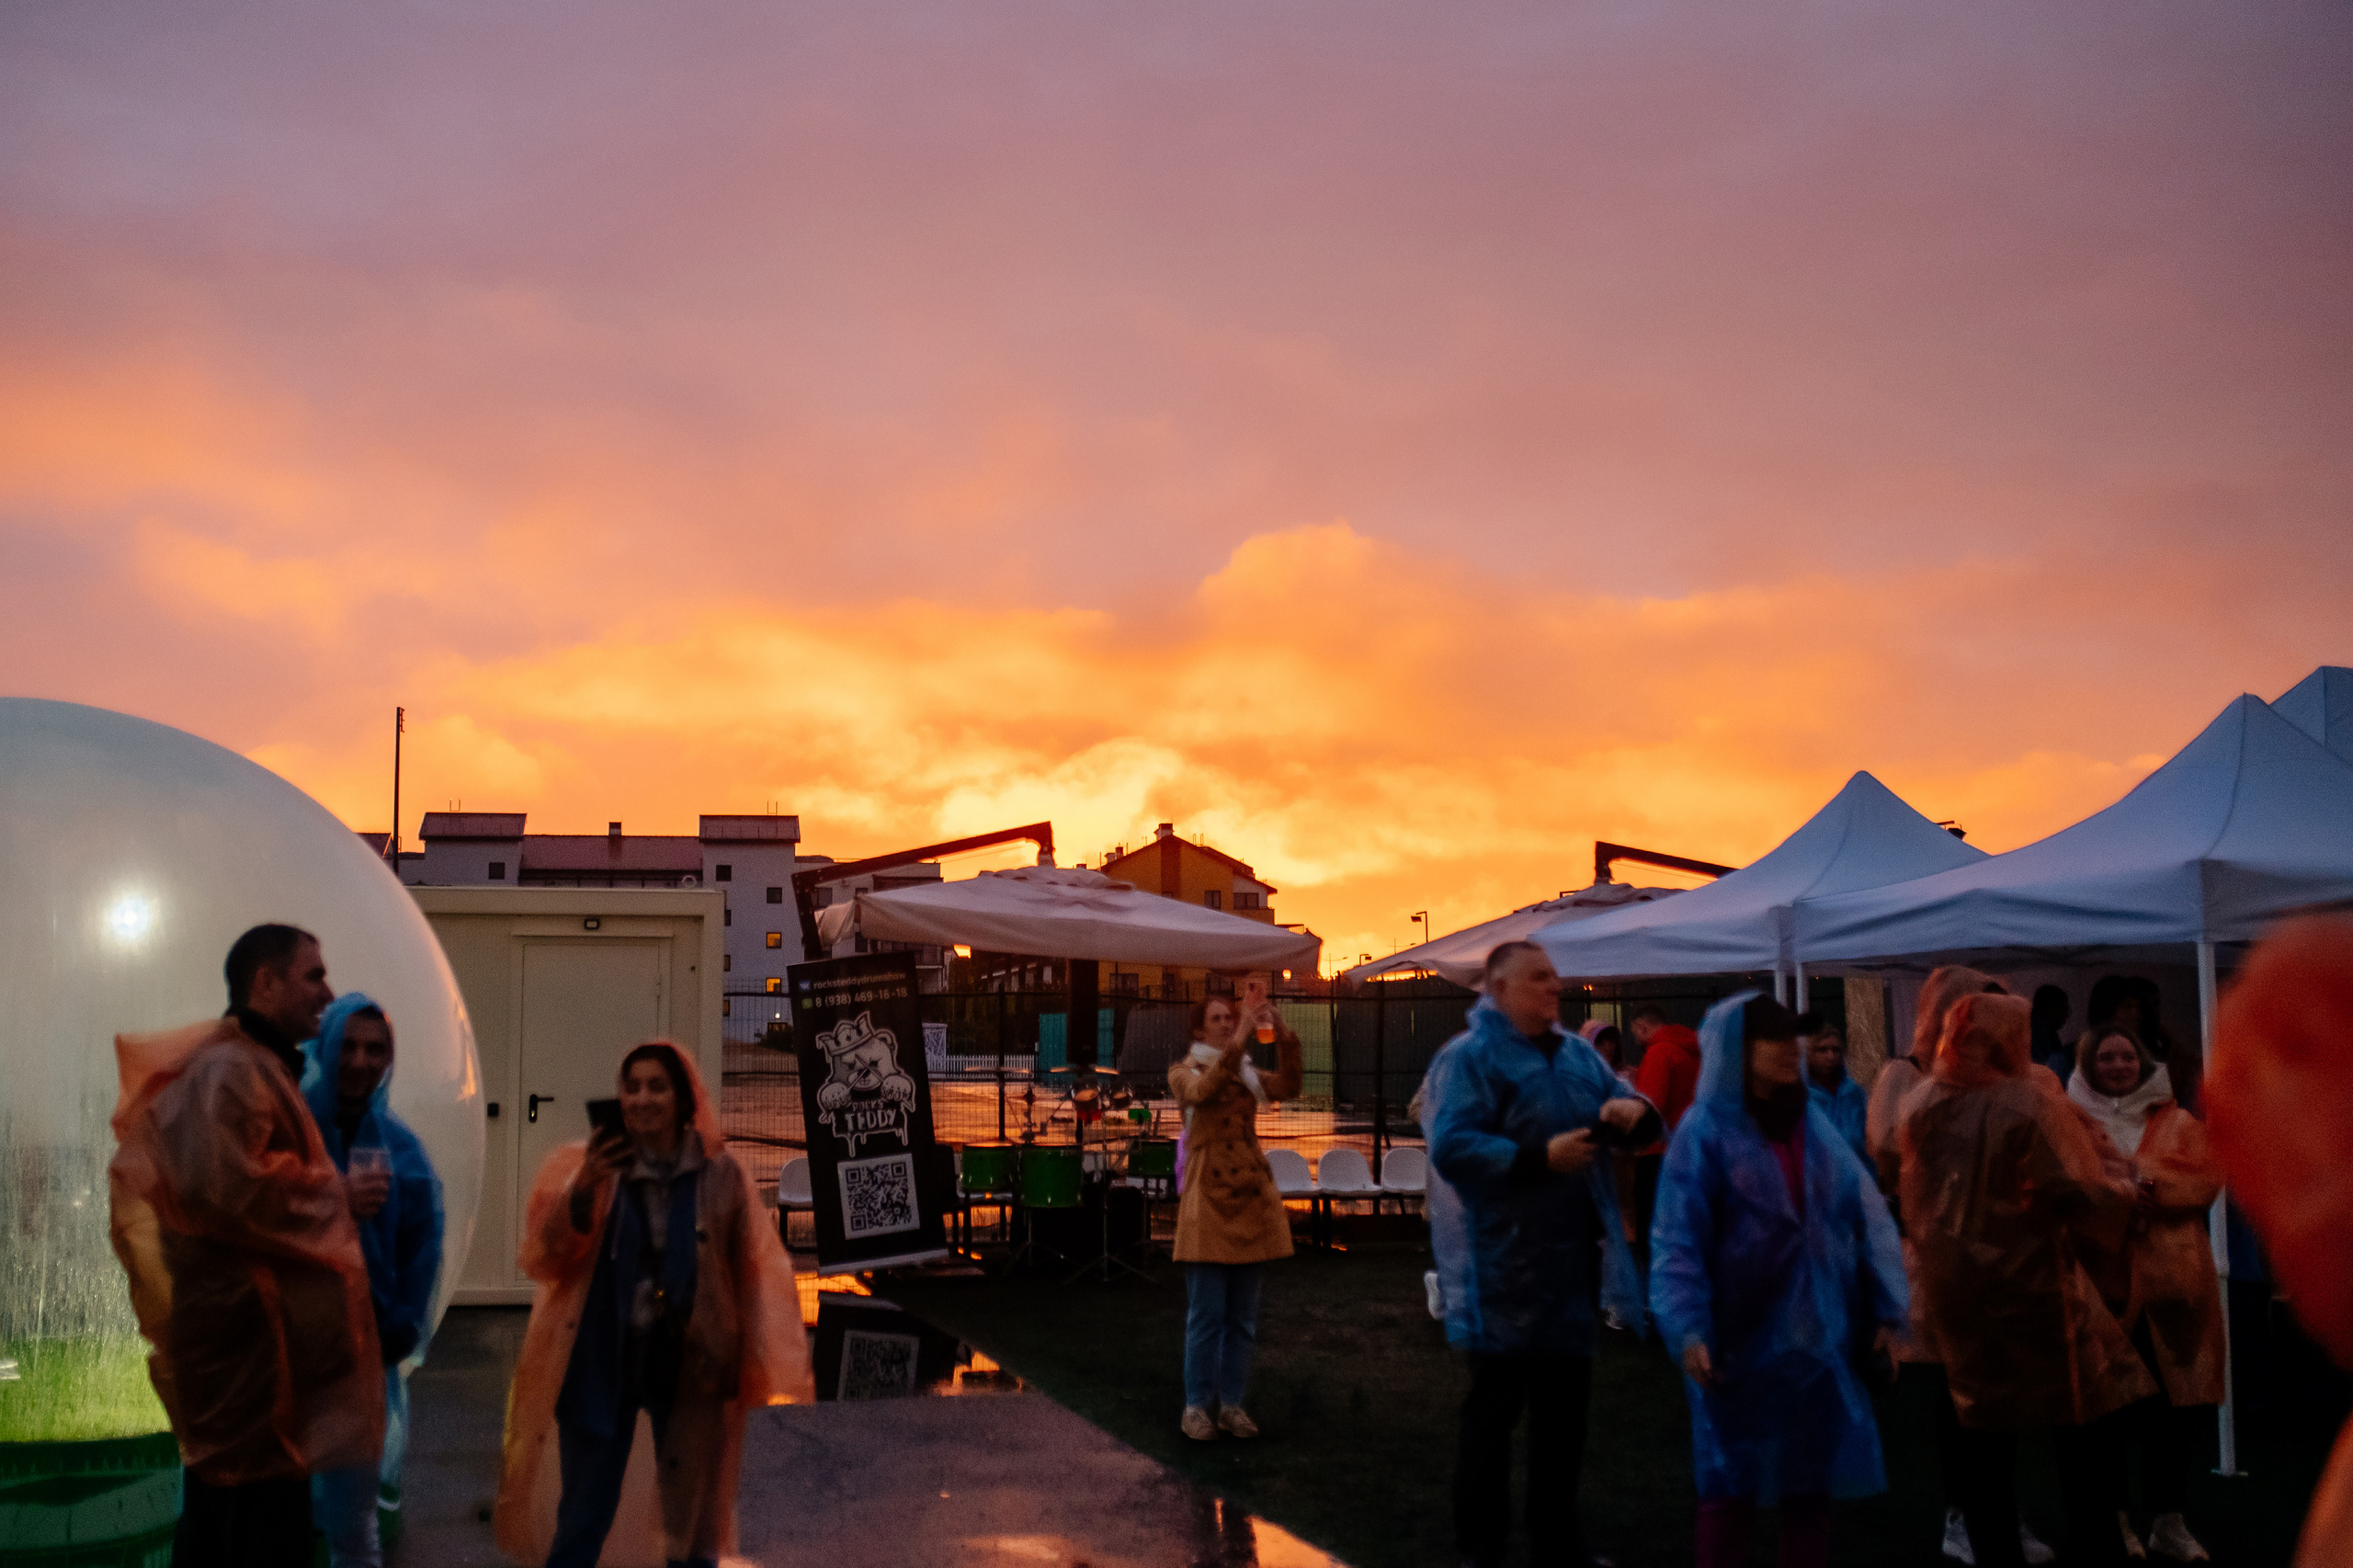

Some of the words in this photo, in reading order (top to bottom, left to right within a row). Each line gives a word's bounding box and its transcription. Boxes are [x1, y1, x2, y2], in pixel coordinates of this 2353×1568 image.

[813, 972, 906, 989] rocksteddydrumshow
[815, 996, 823, 1007] 8
[824, 994, 851, 1007] (938)
[853, 1100, 884, 1112] ROCKS
[845, 1109, 896, 1131] TEDDY
